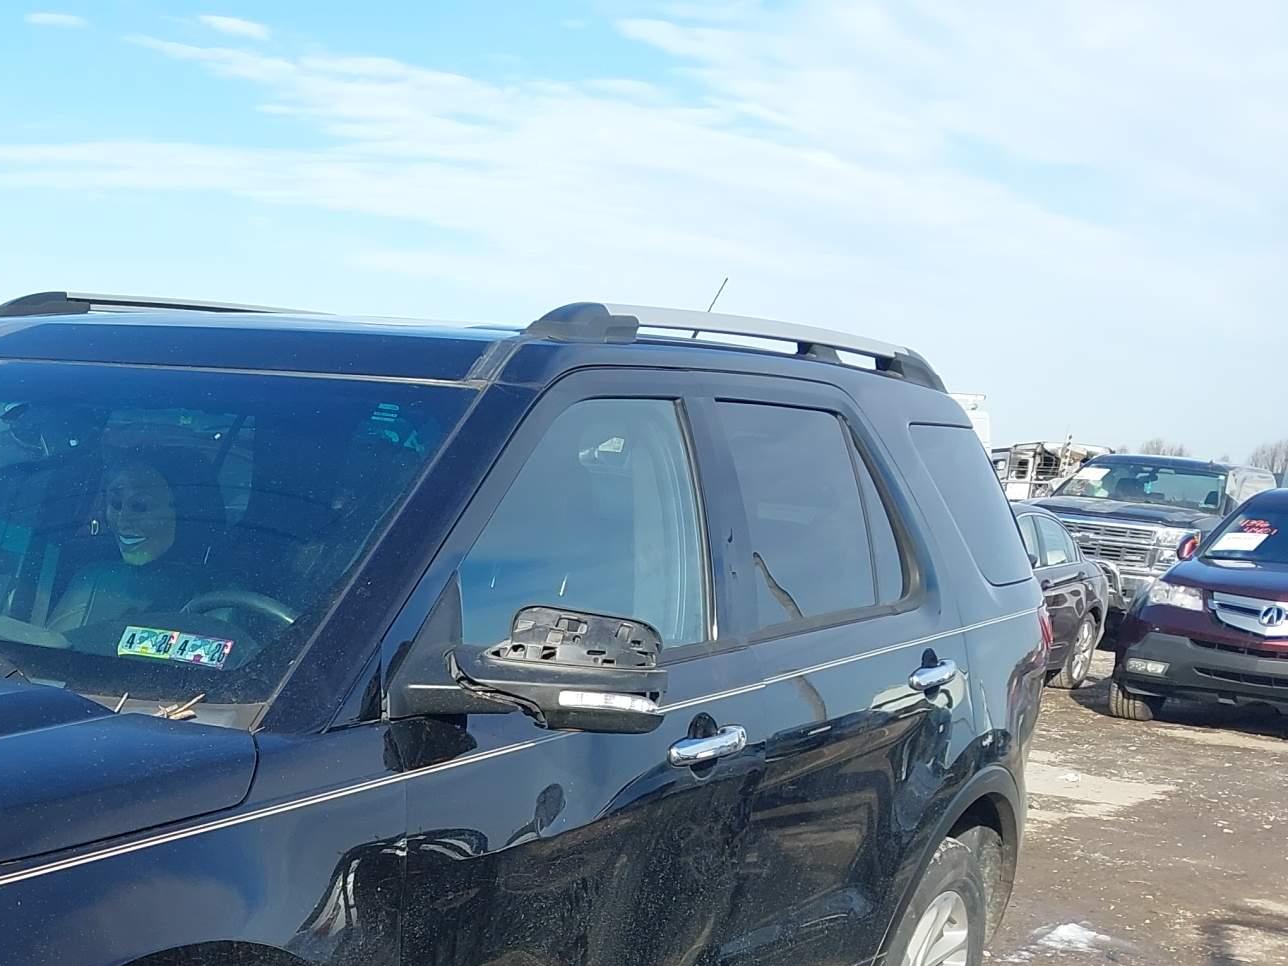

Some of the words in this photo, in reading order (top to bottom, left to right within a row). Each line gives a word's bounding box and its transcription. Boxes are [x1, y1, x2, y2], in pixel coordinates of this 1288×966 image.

[125, 632, 137, 650] 4
[156, 634, 175, 655] 26
[176, 639, 190, 656] 4
